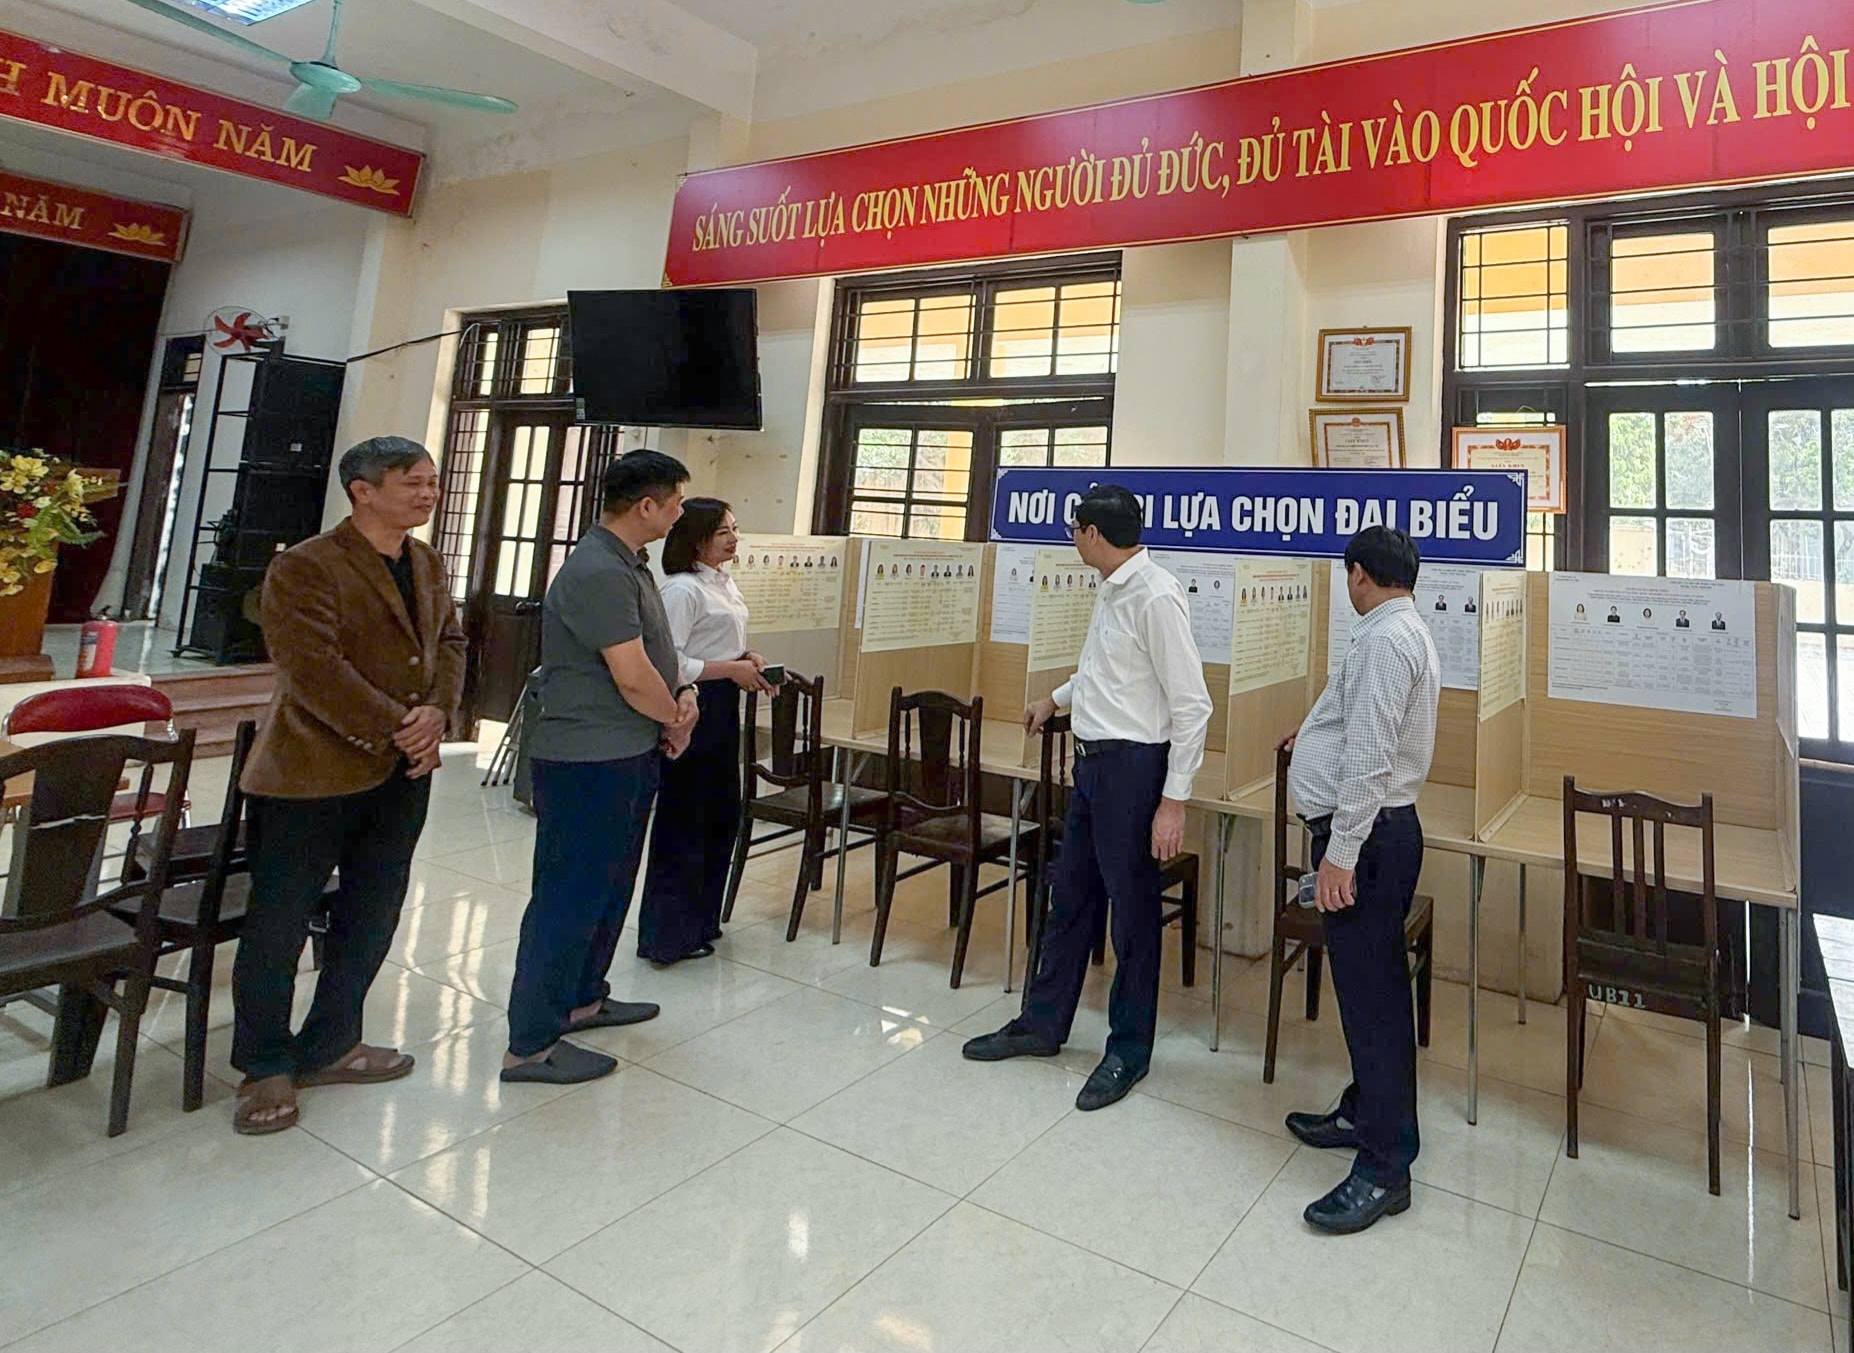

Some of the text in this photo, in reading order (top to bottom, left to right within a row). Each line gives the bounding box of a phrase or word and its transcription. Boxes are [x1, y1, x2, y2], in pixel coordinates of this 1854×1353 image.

[40, 71, 202, 141] MUÔN
[213, 119, 318, 172] NĂM
[693, 34, 1851, 251] SÁNG SUỐT LỰA CHỌN NHỮNG NGƯỜI ĐỦ ĐỨC, ĐỦ TÀI VÀO QUỐC HỘI VÀ HỘI
[0, 191, 85, 230] NĂM
[1008, 489, 1056, 525] NƠI
[1162, 492, 1221, 538] LỰA
[1231, 496, 1324, 542] CHỌN
[1409, 485, 1498, 541] BIỂU
